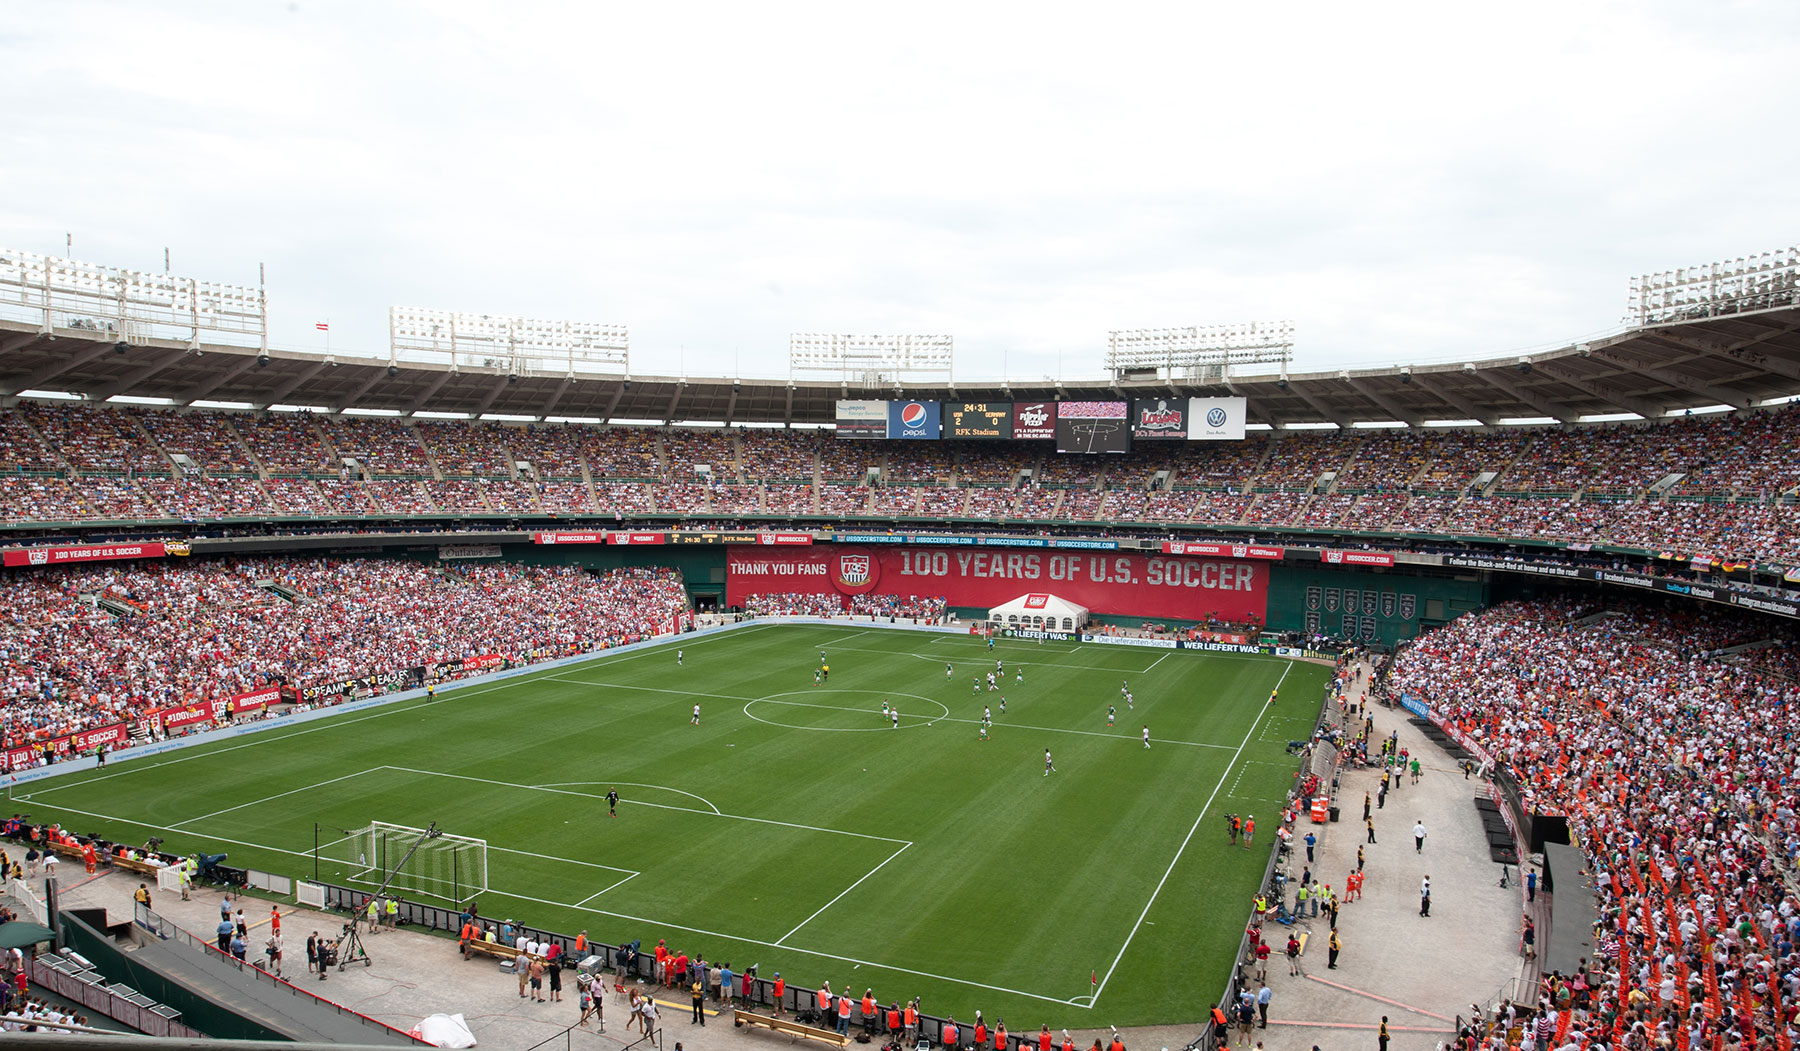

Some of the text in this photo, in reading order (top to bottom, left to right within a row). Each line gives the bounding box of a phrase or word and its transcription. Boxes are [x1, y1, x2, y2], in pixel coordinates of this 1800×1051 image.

[964, 404, 987, 412] 24:31
[972, 428, 999, 436] Stadium
[916, 536, 972, 544] USSOCCERSTORE.COM
[986, 538, 1043, 546] USSOCCERSTORE.COM
[1057, 540, 1115, 549] USSOCCERSTORE.COM
[55, 547, 142, 559] 100 YEARS OF U.S. SOCCER
[445, 548, 483, 557] Outlaws
[1347, 555, 1390, 564] USSOCCER.COM
[730, 563, 827, 575] THANK YOU FANS
[900, 551, 1254, 591] 100 YEARS OF U.S. SOCCER
[1449, 557, 1467, 565] Follow
[1478, 560, 1517, 570] Black-and-Red
[1523, 564, 1538, 572] home
[1556, 567, 1565, 575] the
[1604, 572, 1653, 587] facebook.com/dcunited
[1666, 583, 1684, 592] twitter
[1691, 586, 1714, 599] @dcunited
[1018, 630, 1048, 640] LIEFERT
[1049, 632, 1067, 641] WAS
[1111, 637, 1171, 647] Lieferanten-Suche
[1184, 641, 1203, 650] WER
[1204, 643, 1238, 653] LIEFERT
[1239, 645, 1259, 654] WAS
[1303, 649, 1336, 660] Bitburger
[464, 661, 477, 670] AND
[240, 691, 280, 707] @USSOCCER
[167, 709, 205, 722] #100Years
[11, 751, 28, 764] 100
[88, 729, 118, 744] SOCCER
